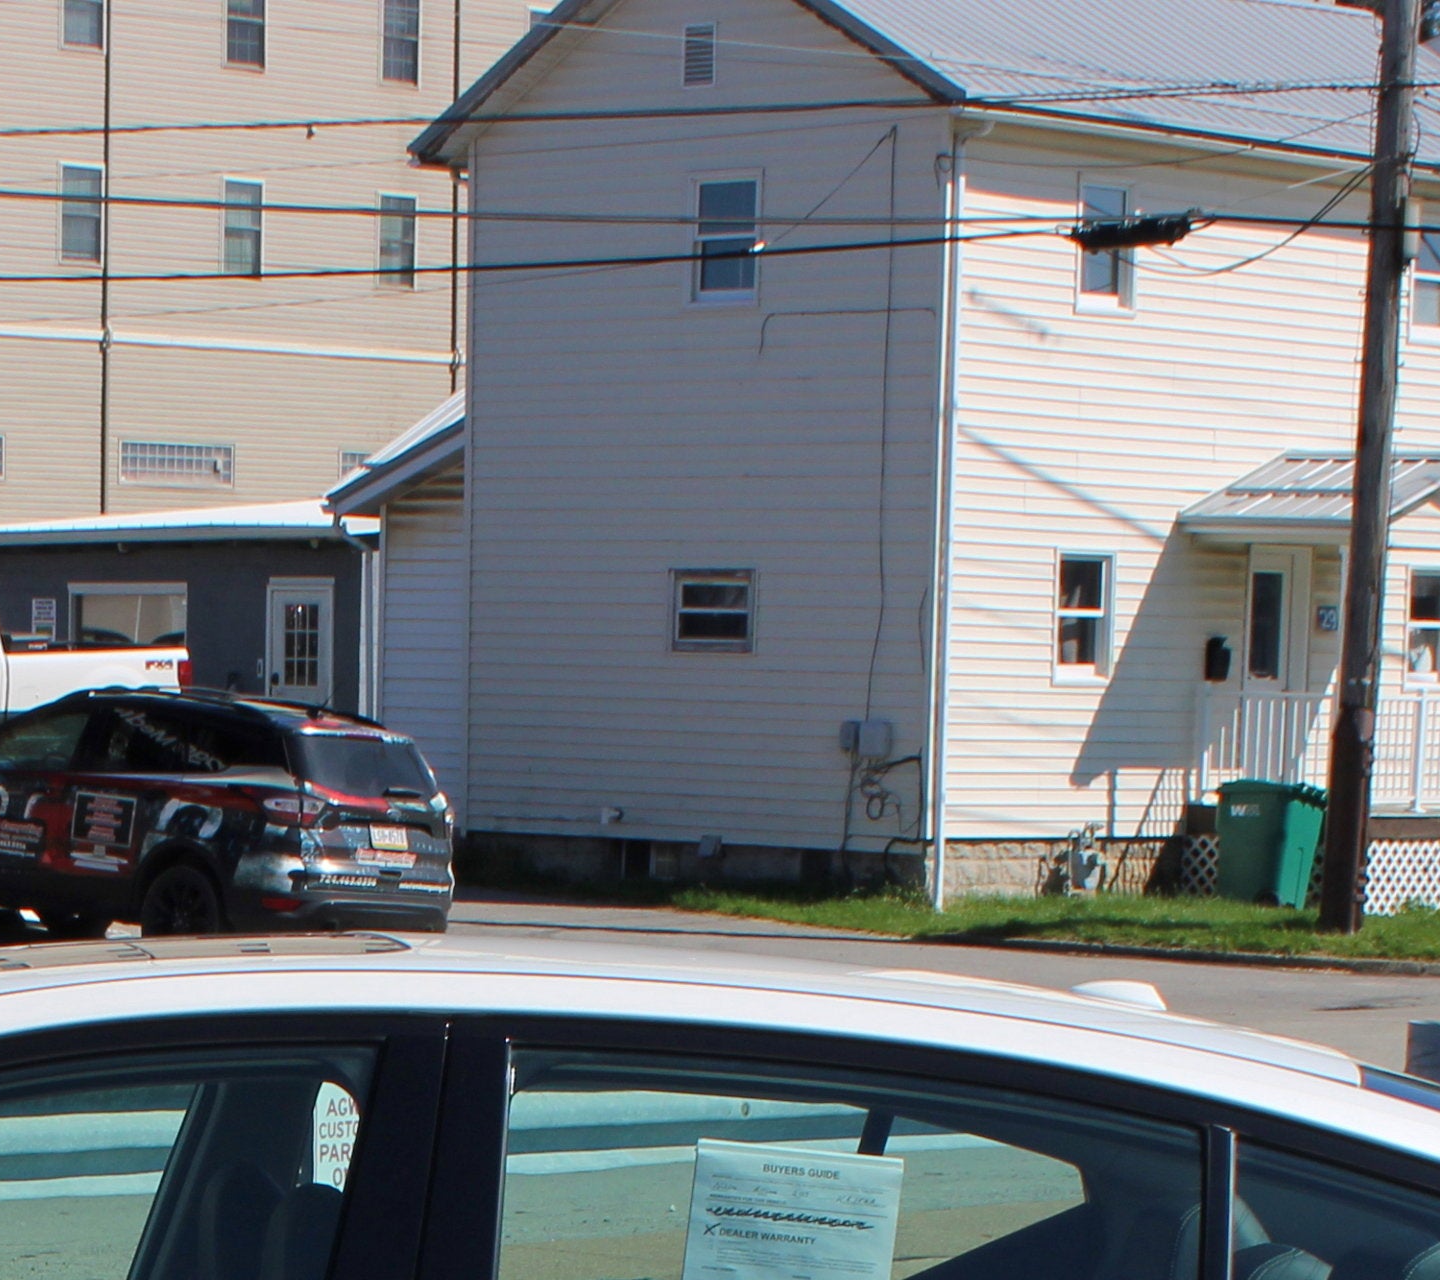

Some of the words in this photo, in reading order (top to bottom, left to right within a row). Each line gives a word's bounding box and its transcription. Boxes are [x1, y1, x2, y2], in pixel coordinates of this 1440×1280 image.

[763, 1163, 805, 1177] BUYERS
[807, 1168, 841, 1180] GUIDE
[720, 1229, 759, 1240] DEALER
[760, 1231, 817, 1246] WARRANTY
